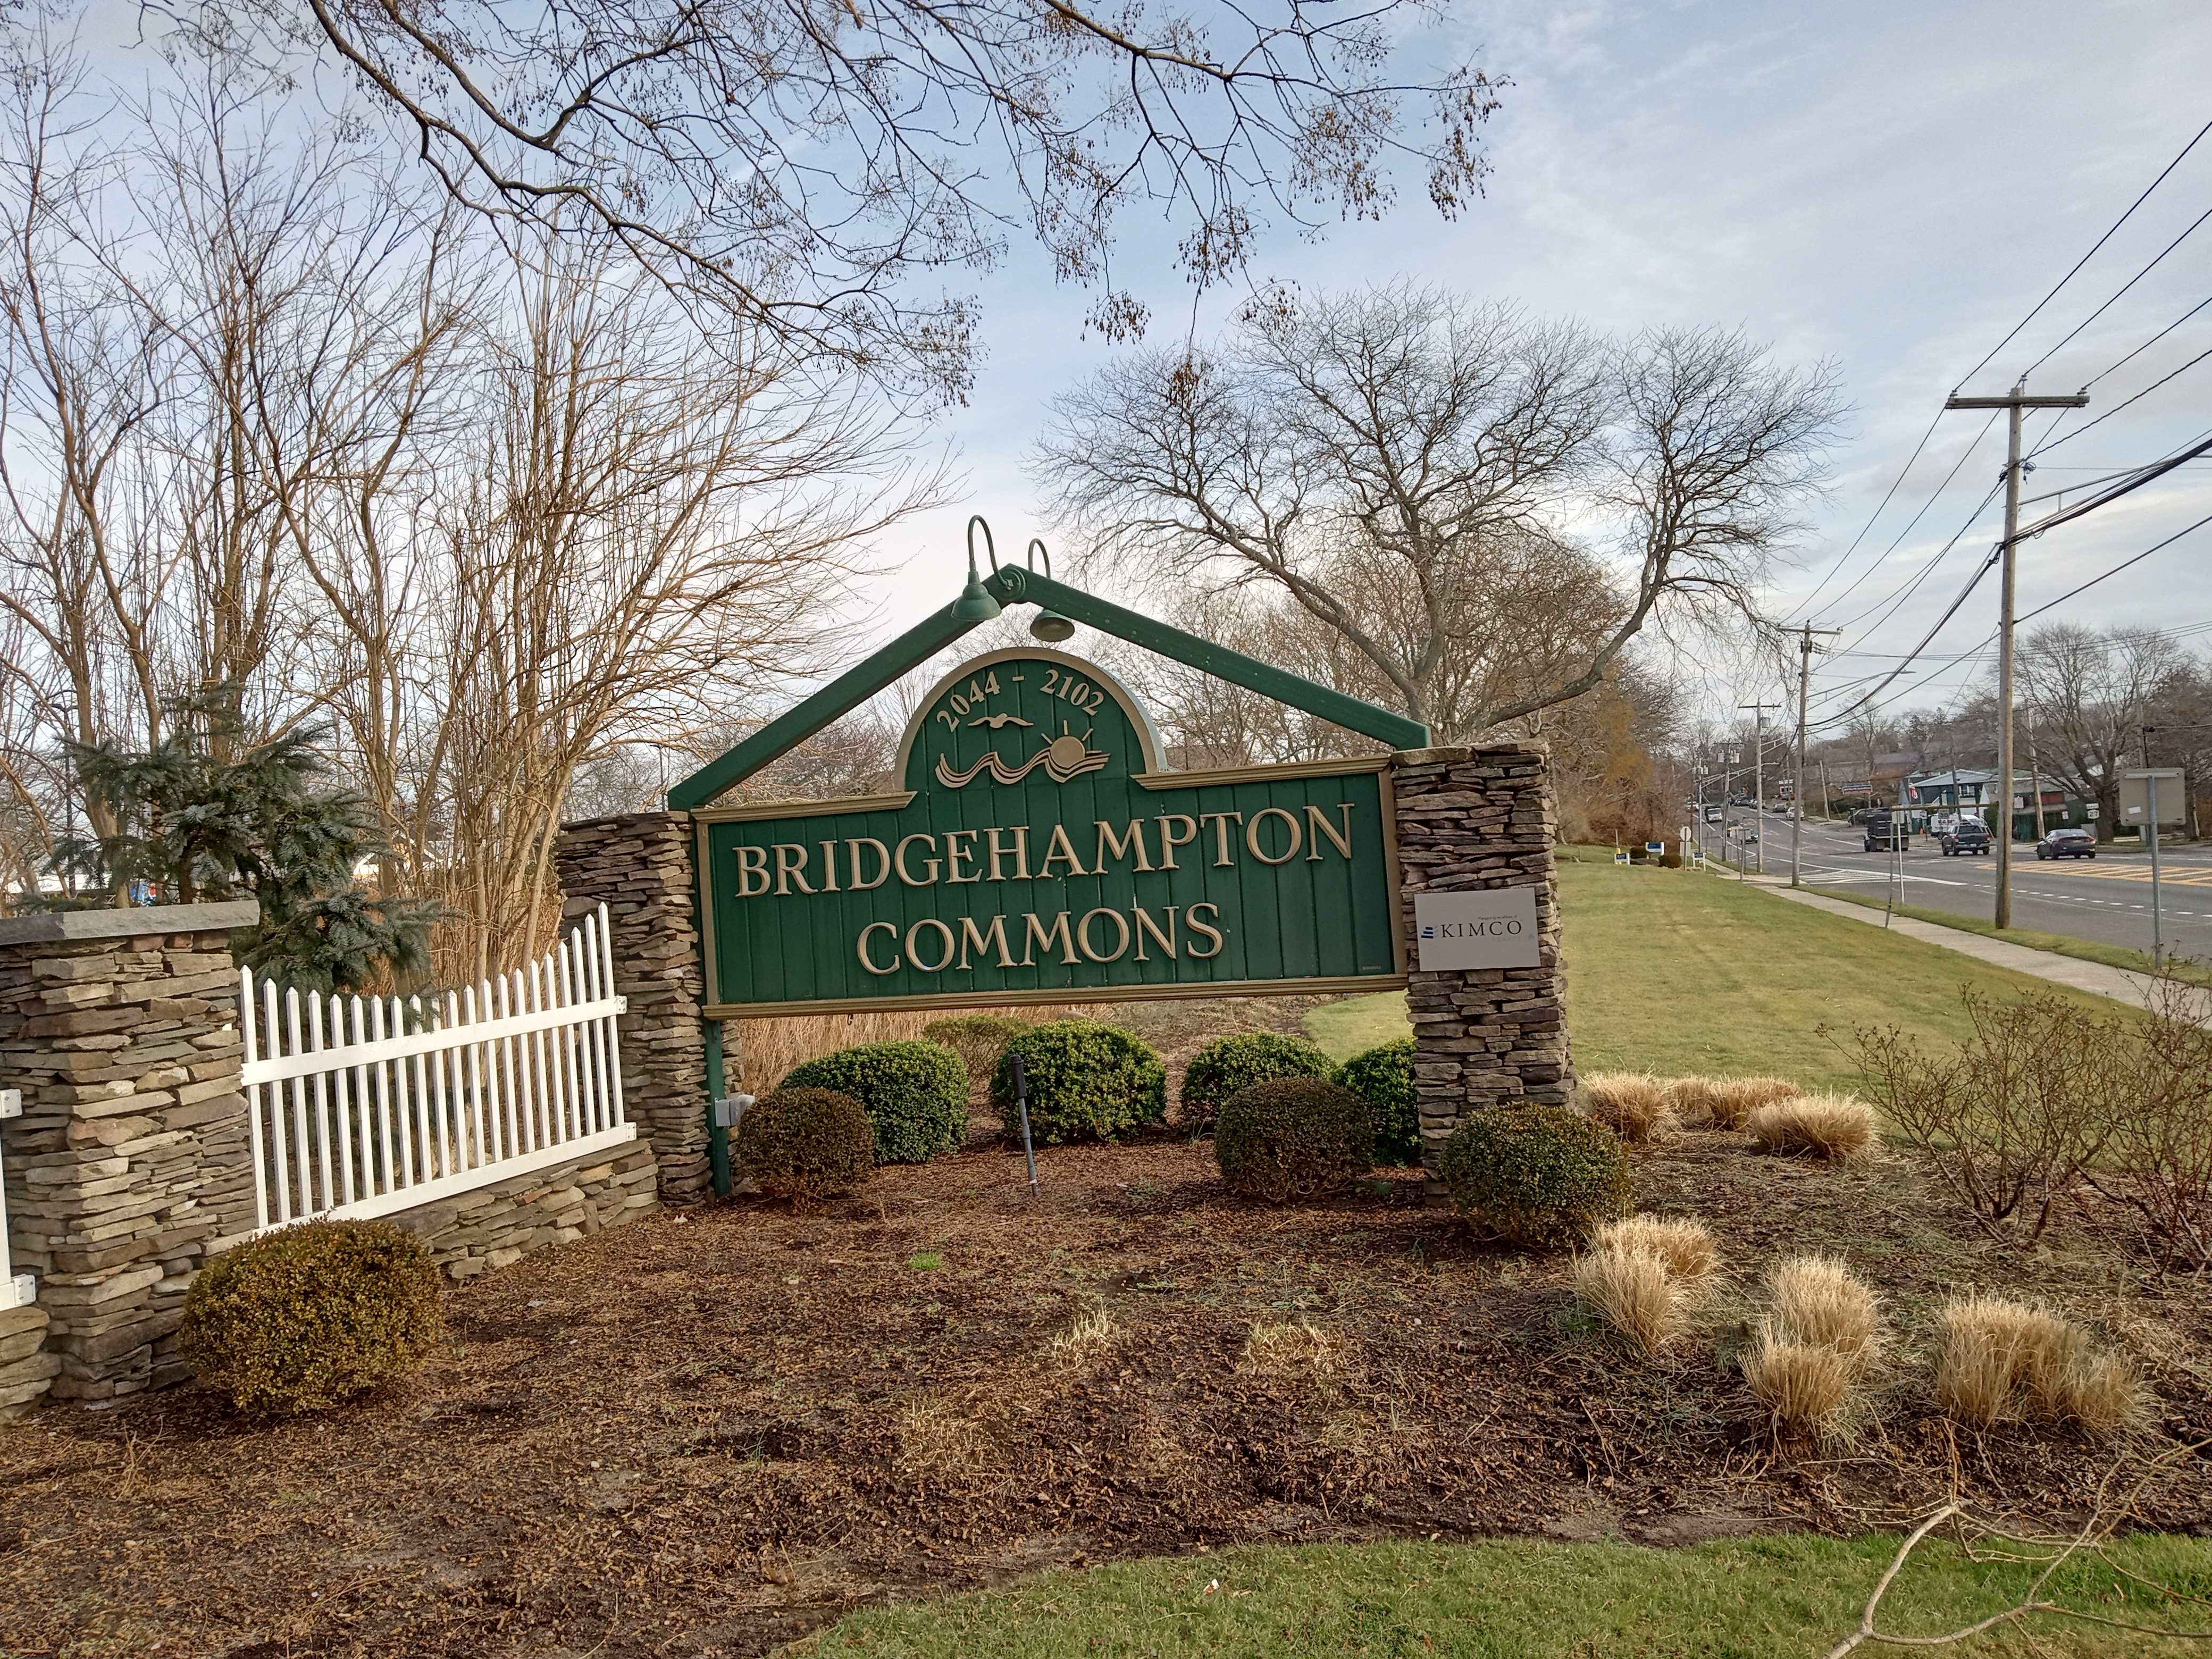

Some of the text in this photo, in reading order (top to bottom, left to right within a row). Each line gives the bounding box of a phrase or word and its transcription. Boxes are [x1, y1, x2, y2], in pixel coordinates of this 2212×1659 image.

[936, 671, 1000, 733] 2044
[1040, 669, 1104, 716] 2102
[732, 803, 1355, 899] BRIDGEHAMPTON
[857, 903, 1223, 975] COMMONS
[1441, 920, 1522, 938] KIMCO
